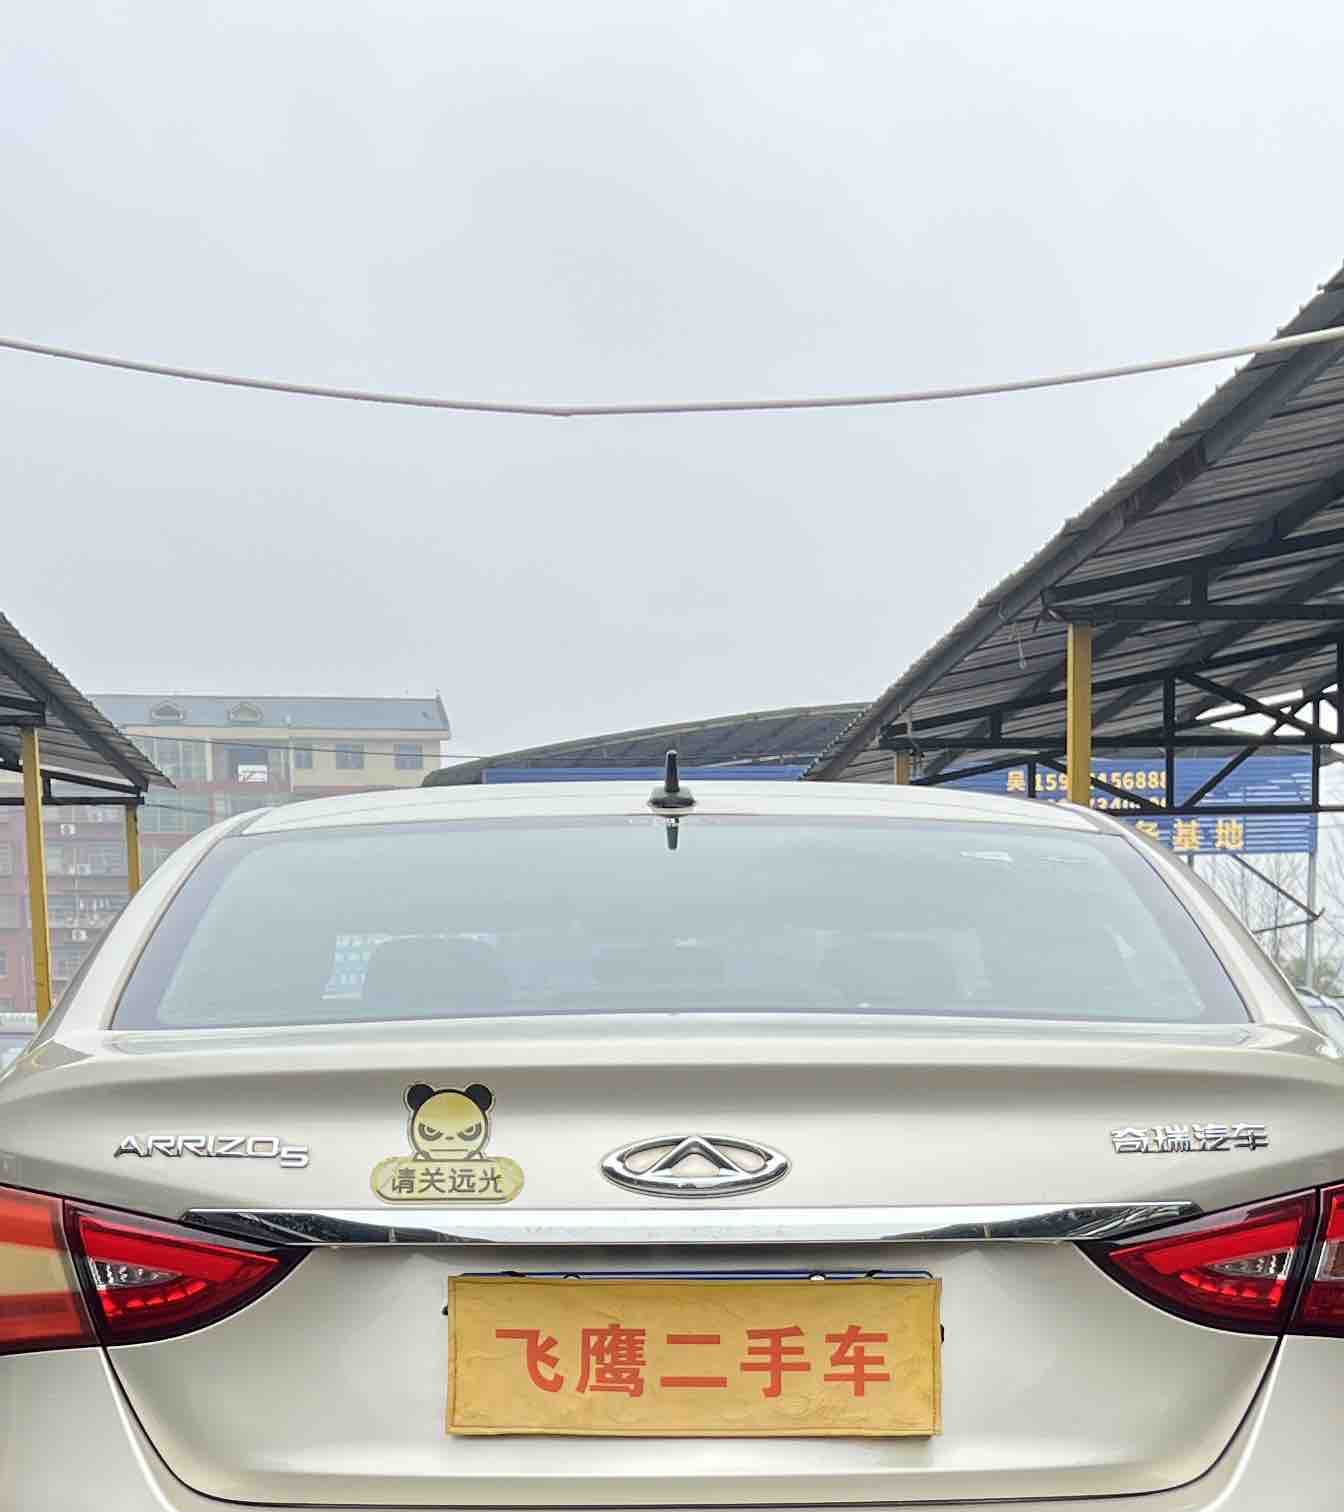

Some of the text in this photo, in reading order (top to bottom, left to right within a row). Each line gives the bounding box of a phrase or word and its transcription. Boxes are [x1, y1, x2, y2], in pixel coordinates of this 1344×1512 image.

[1110, 1122, 1270, 1154] 奇瑞汽车
[391, 1167, 504, 1194] 请关远光
[495, 1323, 891, 1398] 飞鹰二手车
